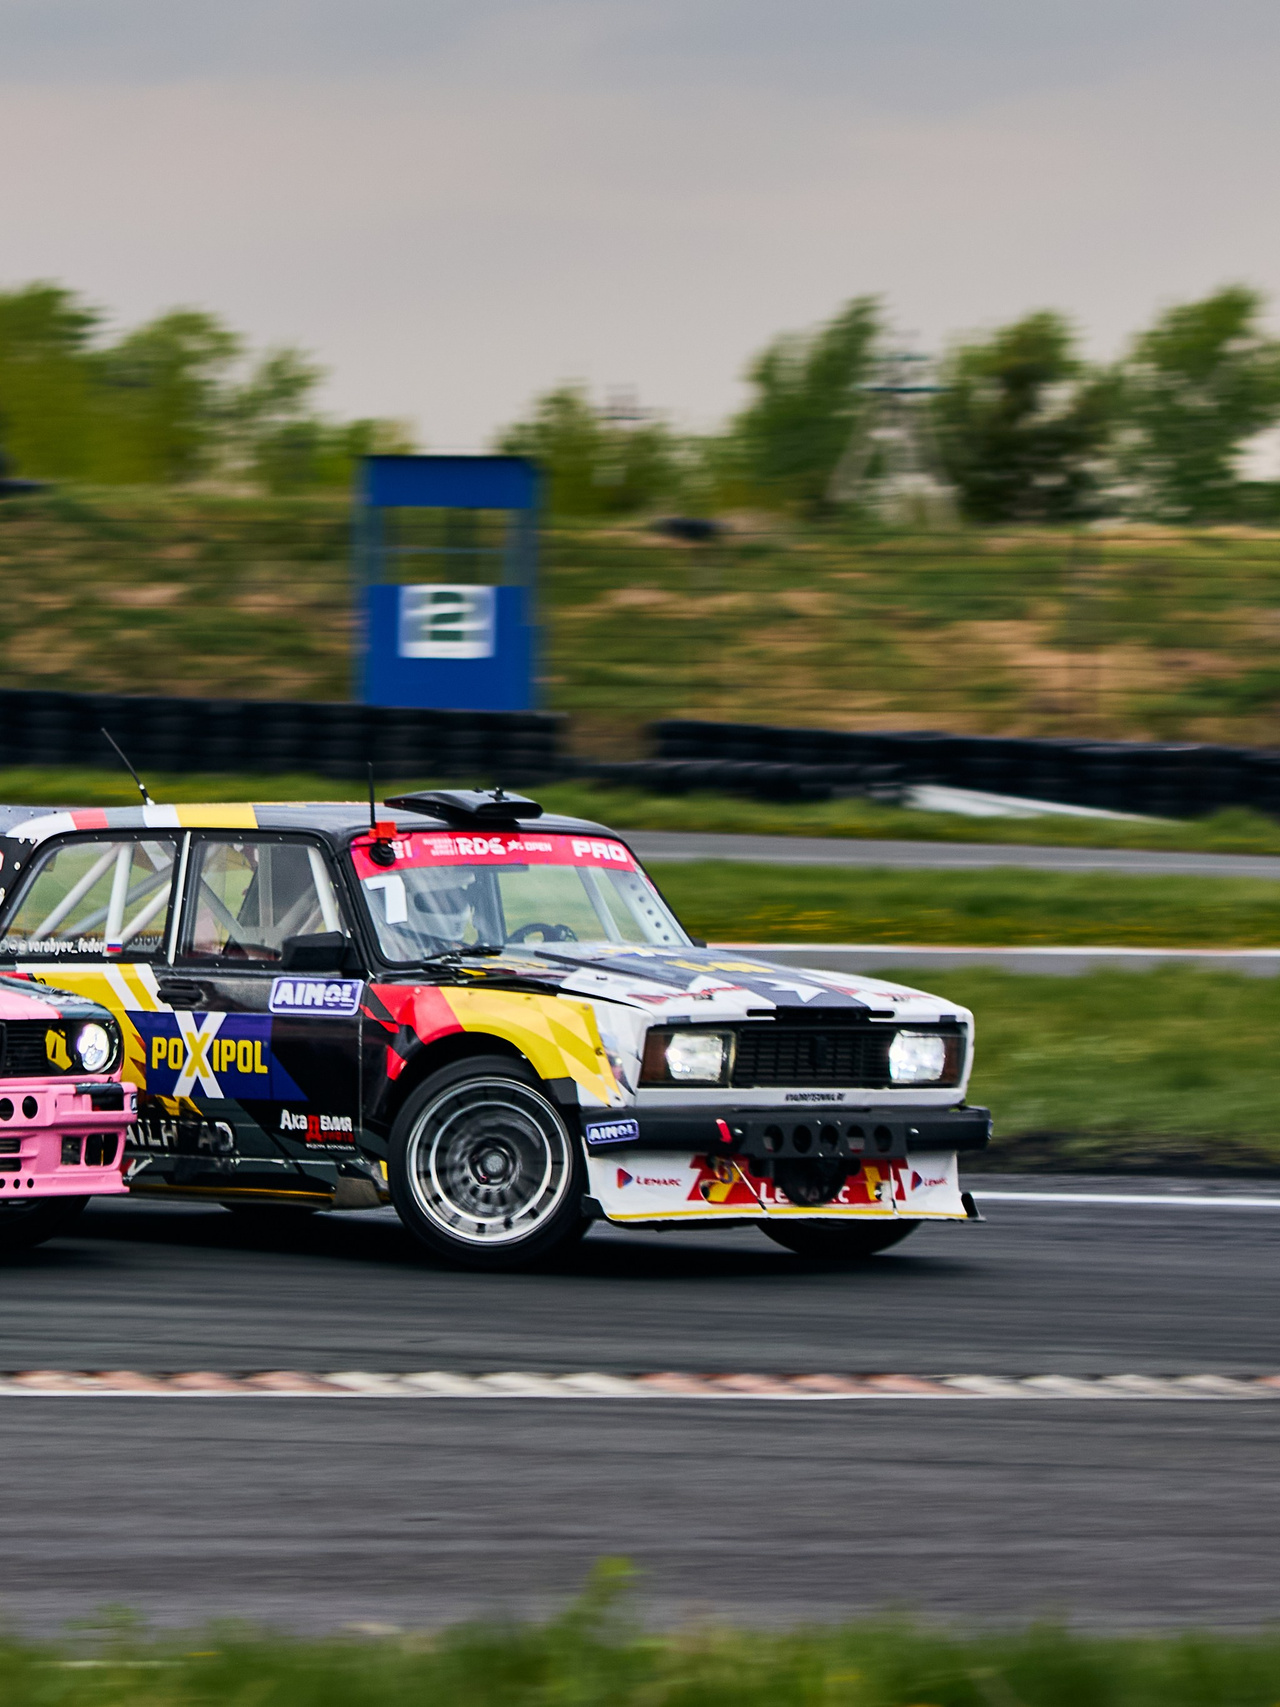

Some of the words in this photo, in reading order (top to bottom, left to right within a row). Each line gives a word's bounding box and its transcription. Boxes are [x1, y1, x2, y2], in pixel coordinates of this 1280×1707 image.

[456, 837, 506, 855] RDS
[524, 841, 553, 852] OPEN
[571, 840, 629, 863] PRO
[151, 1012, 269, 1098] POXIPOL
